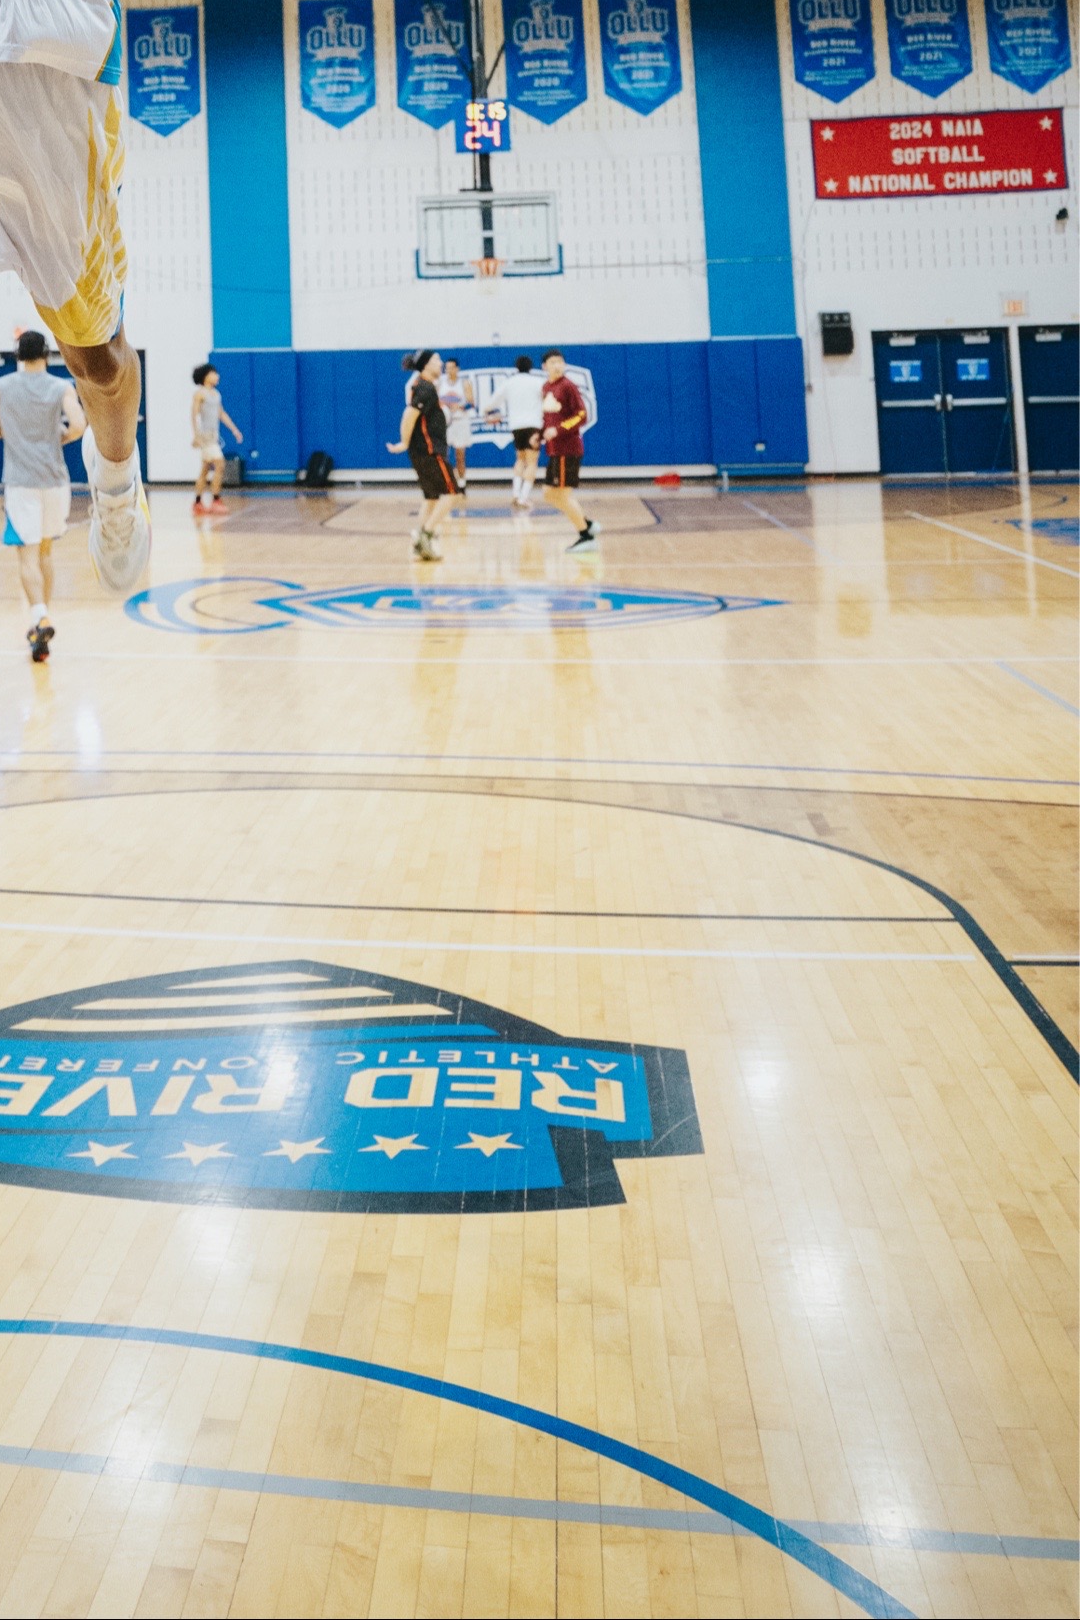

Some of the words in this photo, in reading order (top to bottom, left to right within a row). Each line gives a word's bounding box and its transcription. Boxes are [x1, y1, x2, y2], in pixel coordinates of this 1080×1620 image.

[514, 16, 573, 45] OLLU
[608, 8, 668, 39] OLLU
[135, 35, 191, 62] OLLU
[307, 25, 366, 52] OLLU
[464, 120, 501, 150] 24
[889, 121, 933, 140] 2024
[941, 118, 984, 137] NAIA
[891, 145, 985, 165] SOFTBALL
[848, 173, 936, 193] NATIONAL
[943, 168, 1033, 189] CHAMPION
[335, 1050, 619, 1074] ATHLETIC
[344, 1066, 626, 1123] RED
